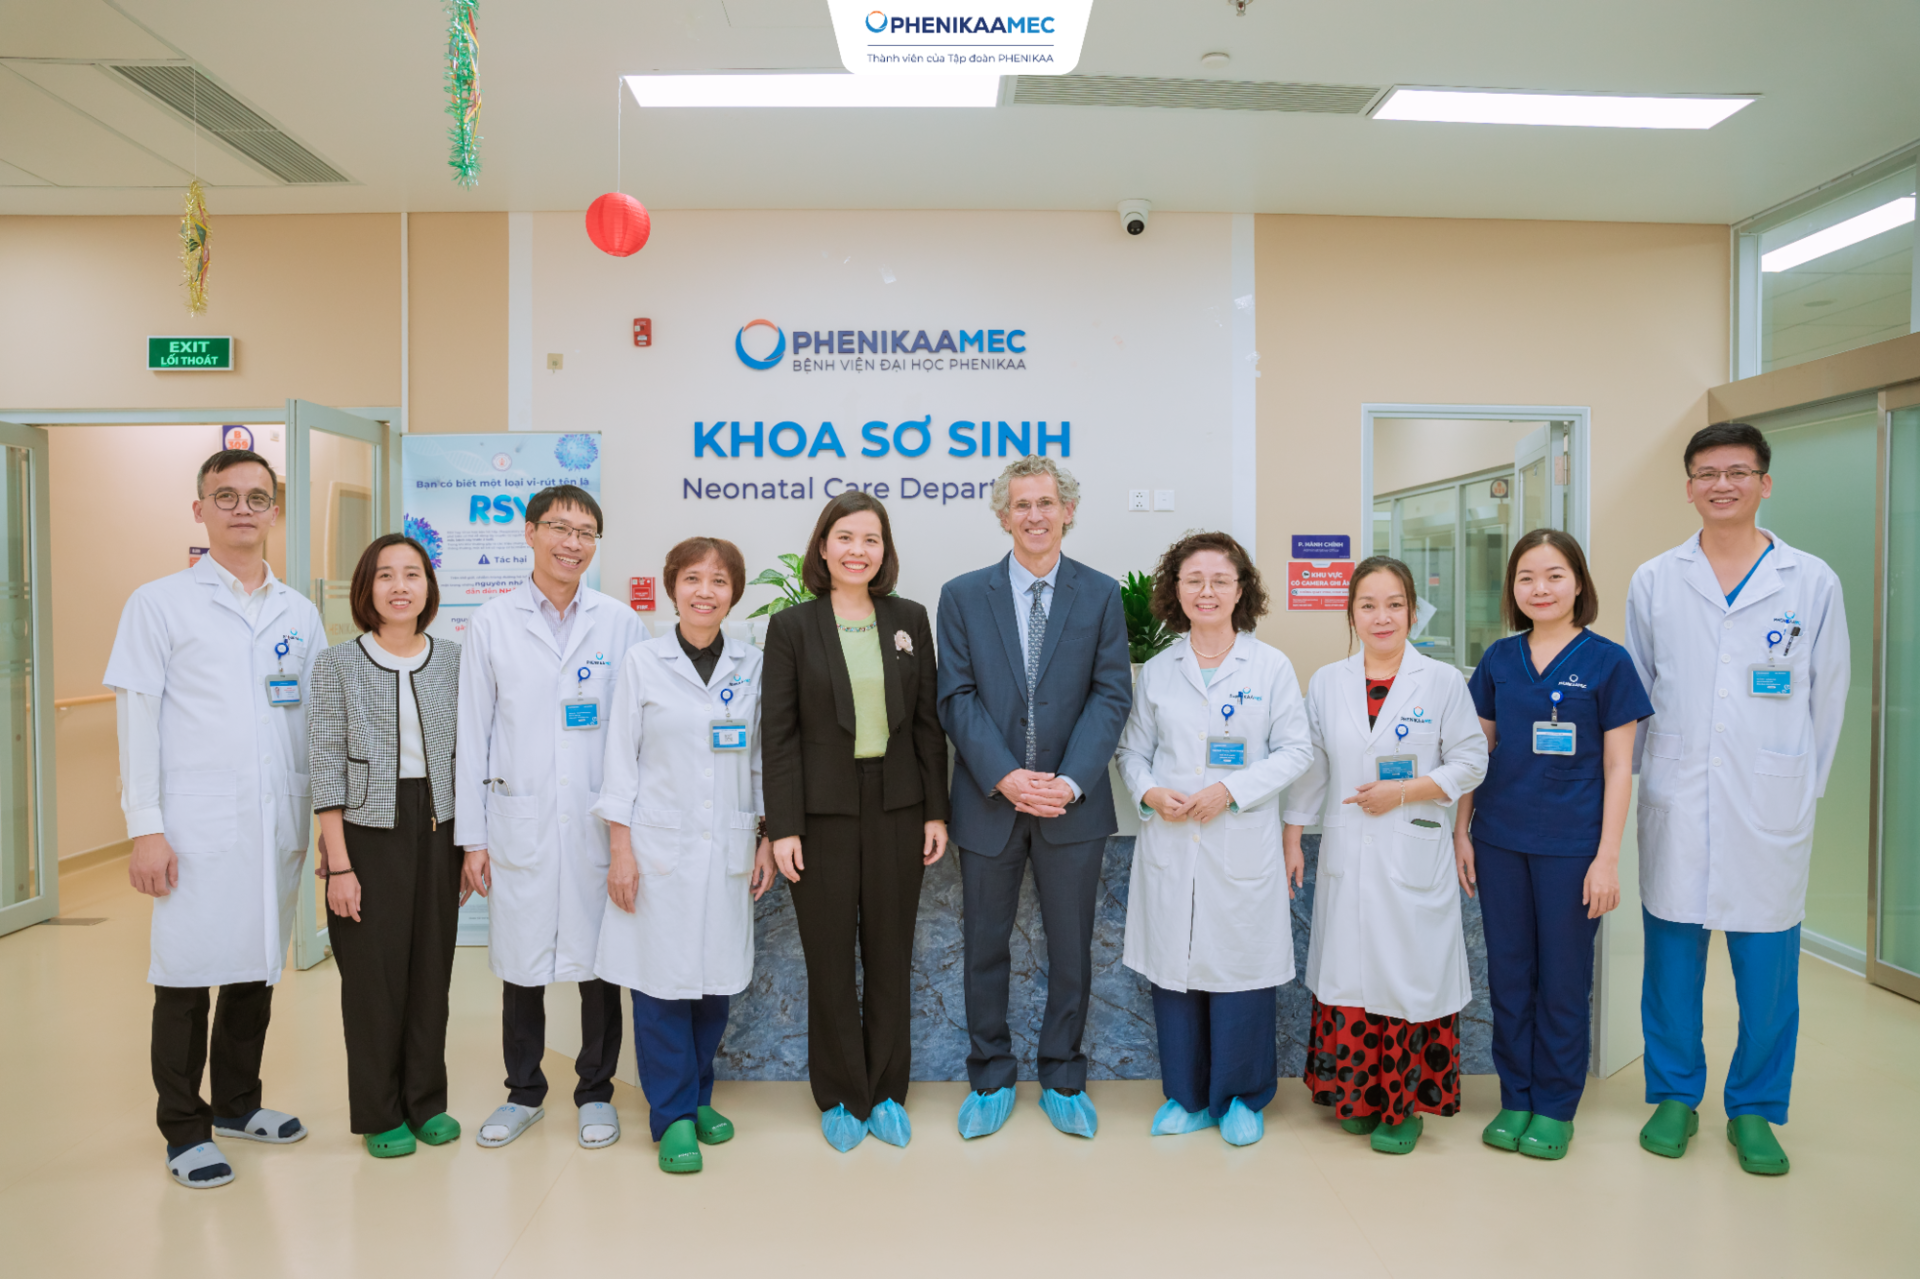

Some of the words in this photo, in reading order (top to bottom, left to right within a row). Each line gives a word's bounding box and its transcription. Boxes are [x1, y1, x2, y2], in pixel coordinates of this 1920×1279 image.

[169, 341, 210, 353] EXIT
[792, 329, 1027, 355] PHENIKAAMEC
[161, 353, 179, 366] LỐI
[181, 354, 218, 365] THOÁT
[793, 357, 835, 374] BỆNH
[840, 357, 875, 374] VIỆN
[880, 358, 906, 373] ĐẠI
[911, 358, 944, 373] HỌC
[949, 358, 1027, 371] PHENIKAA
[234, 430, 242, 439] B
[694, 421, 846, 458] KHOA
[861, 413, 932, 458] SƠ
[948, 420, 1071, 458] SINH
[228, 440, 249, 450] 309
[416, 480, 438, 490] Bạn
[440, 478, 453, 488] có
[456, 478, 477, 488] biết
[480, 478, 501, 489] một
[504, 478, 524, 488] loại
[527, 478, 556, 487] vi-rút
[580, 478, 590, 486] là
[682, 476, 814, 500] Neonatal
[823, 477, 890, 500] Care
[513, 554, 527, 565] hại
